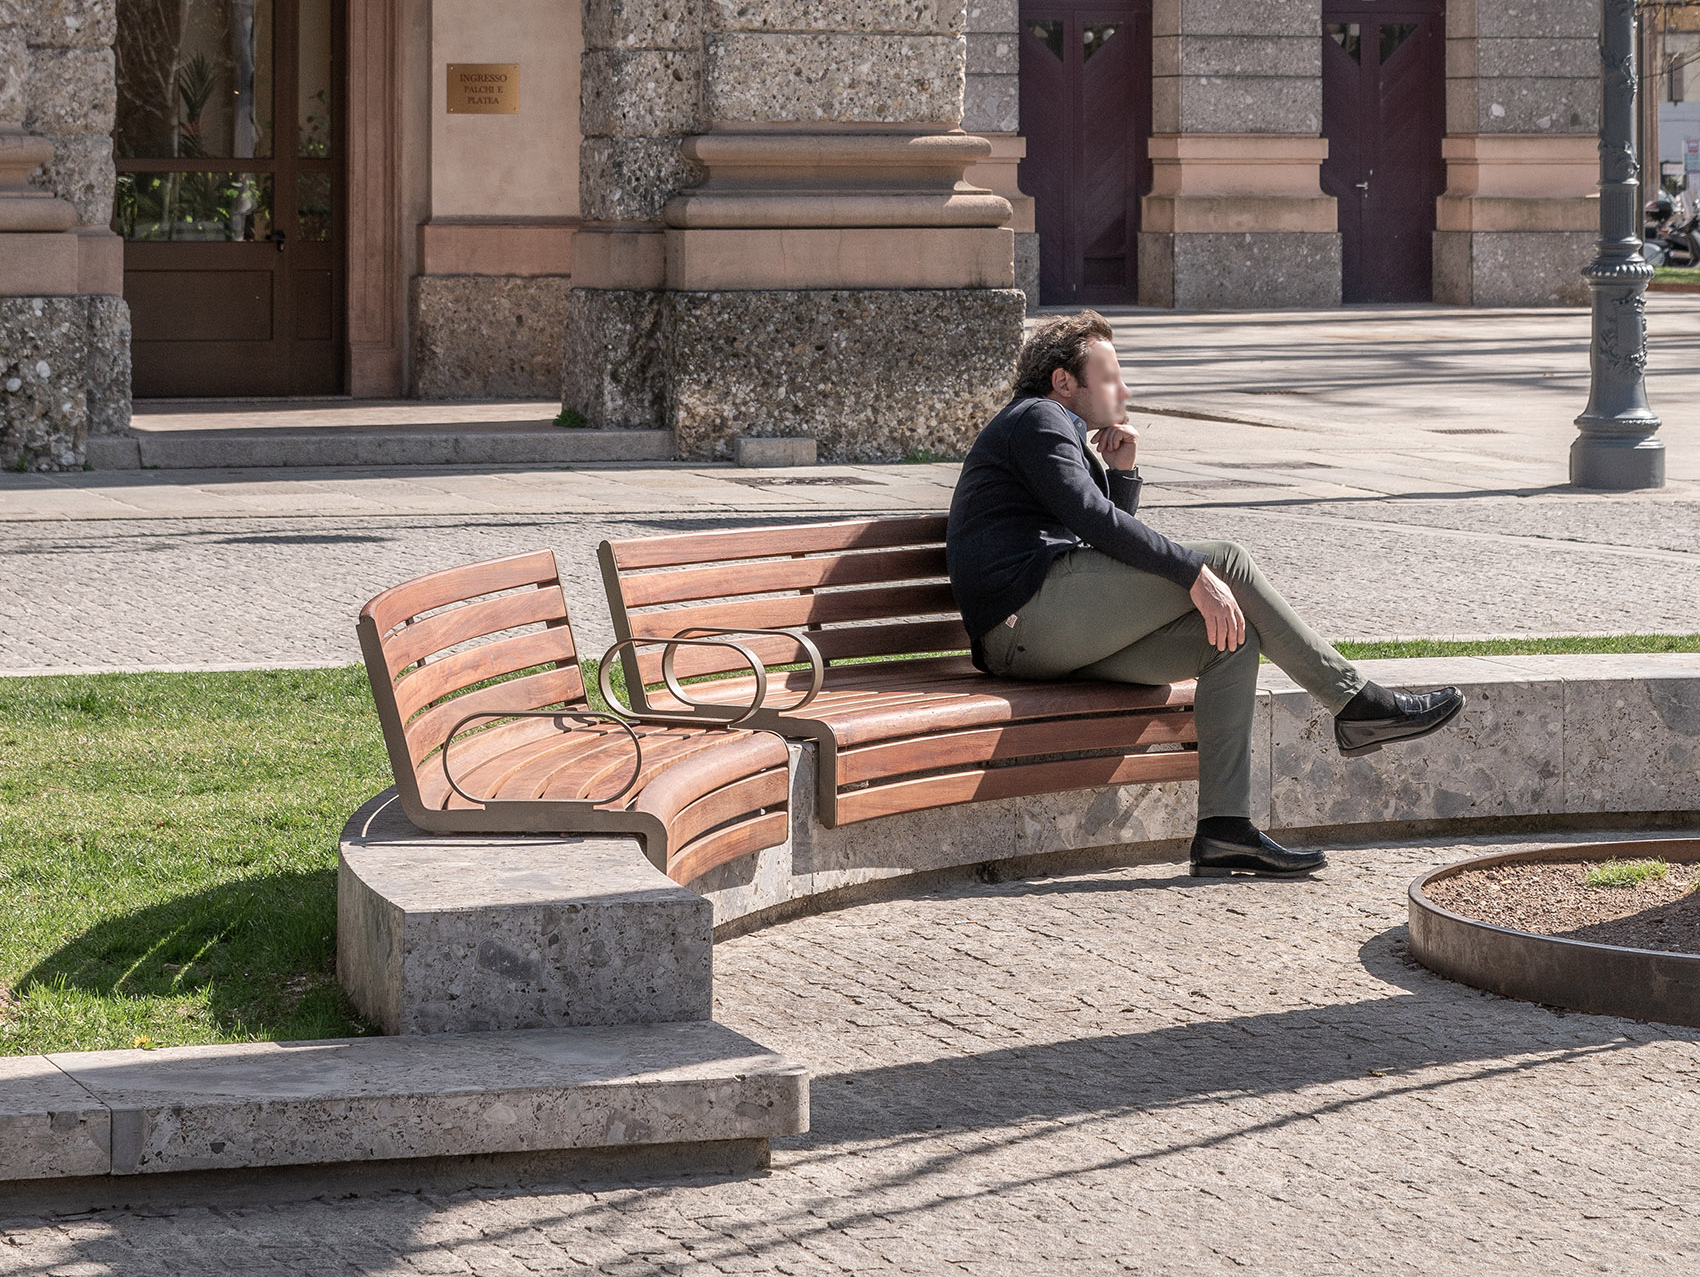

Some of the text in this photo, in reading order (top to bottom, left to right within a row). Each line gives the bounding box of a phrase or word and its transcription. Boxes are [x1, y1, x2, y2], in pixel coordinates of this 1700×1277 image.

[460, 73, 508, 83] INGRESSO
[464, 85, 504, 94] PALCHI E
[467, 96, 500, 105] PLATEA
